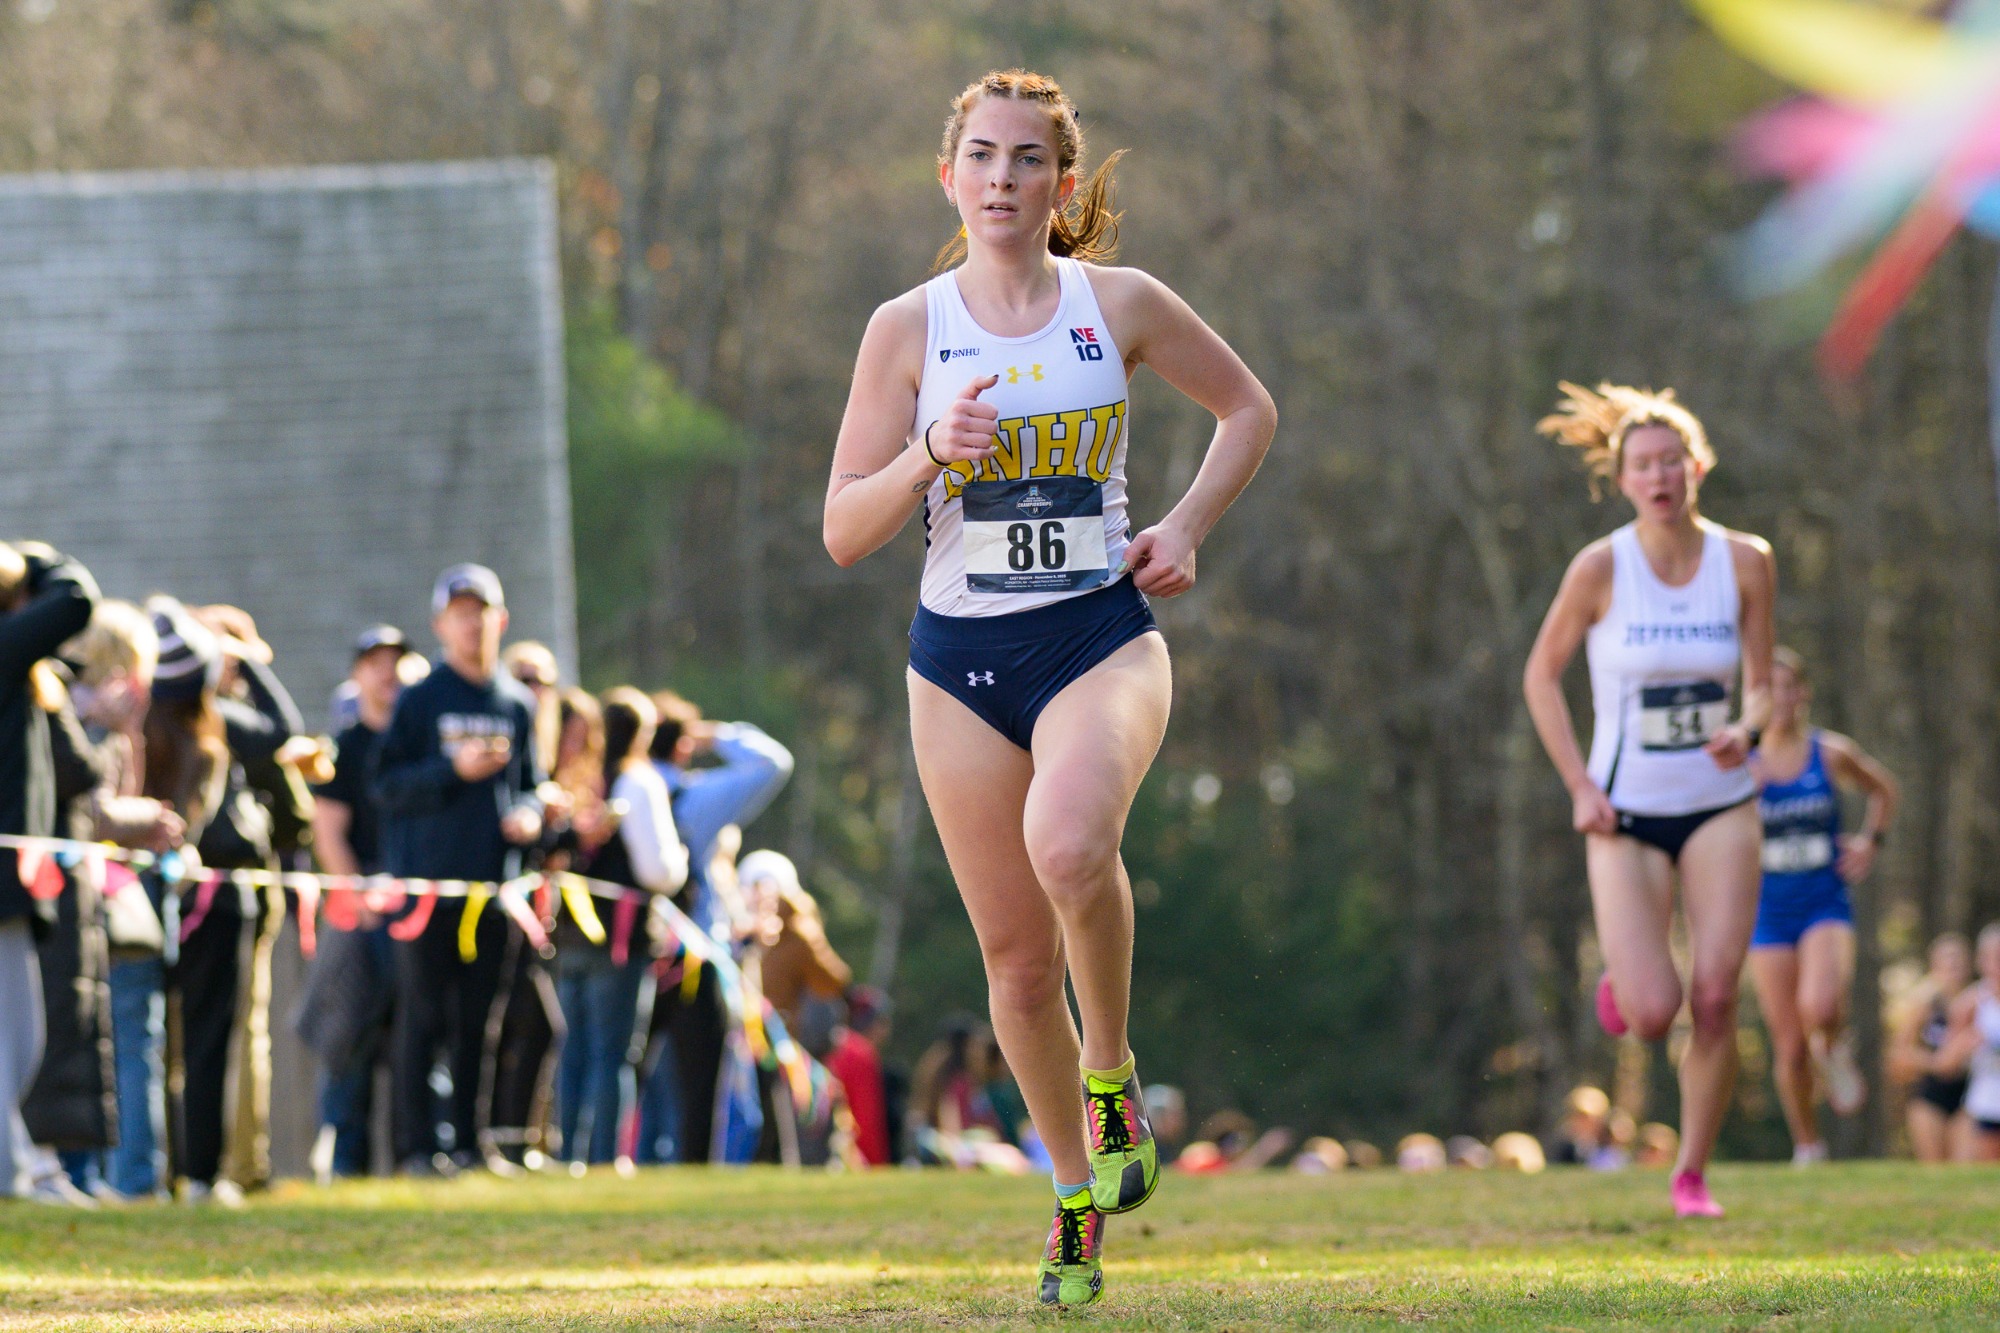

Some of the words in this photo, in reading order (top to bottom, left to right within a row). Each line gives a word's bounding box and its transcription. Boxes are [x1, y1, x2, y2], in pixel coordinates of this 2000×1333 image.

[1069, 327, 1099, 343] NE
[952, 347, 980, 358] SNHU
[1075, 344, 1103, 361] 10
[1007, 521, 1066, 571] 86
[1668, 708, 1703, 743] 54
